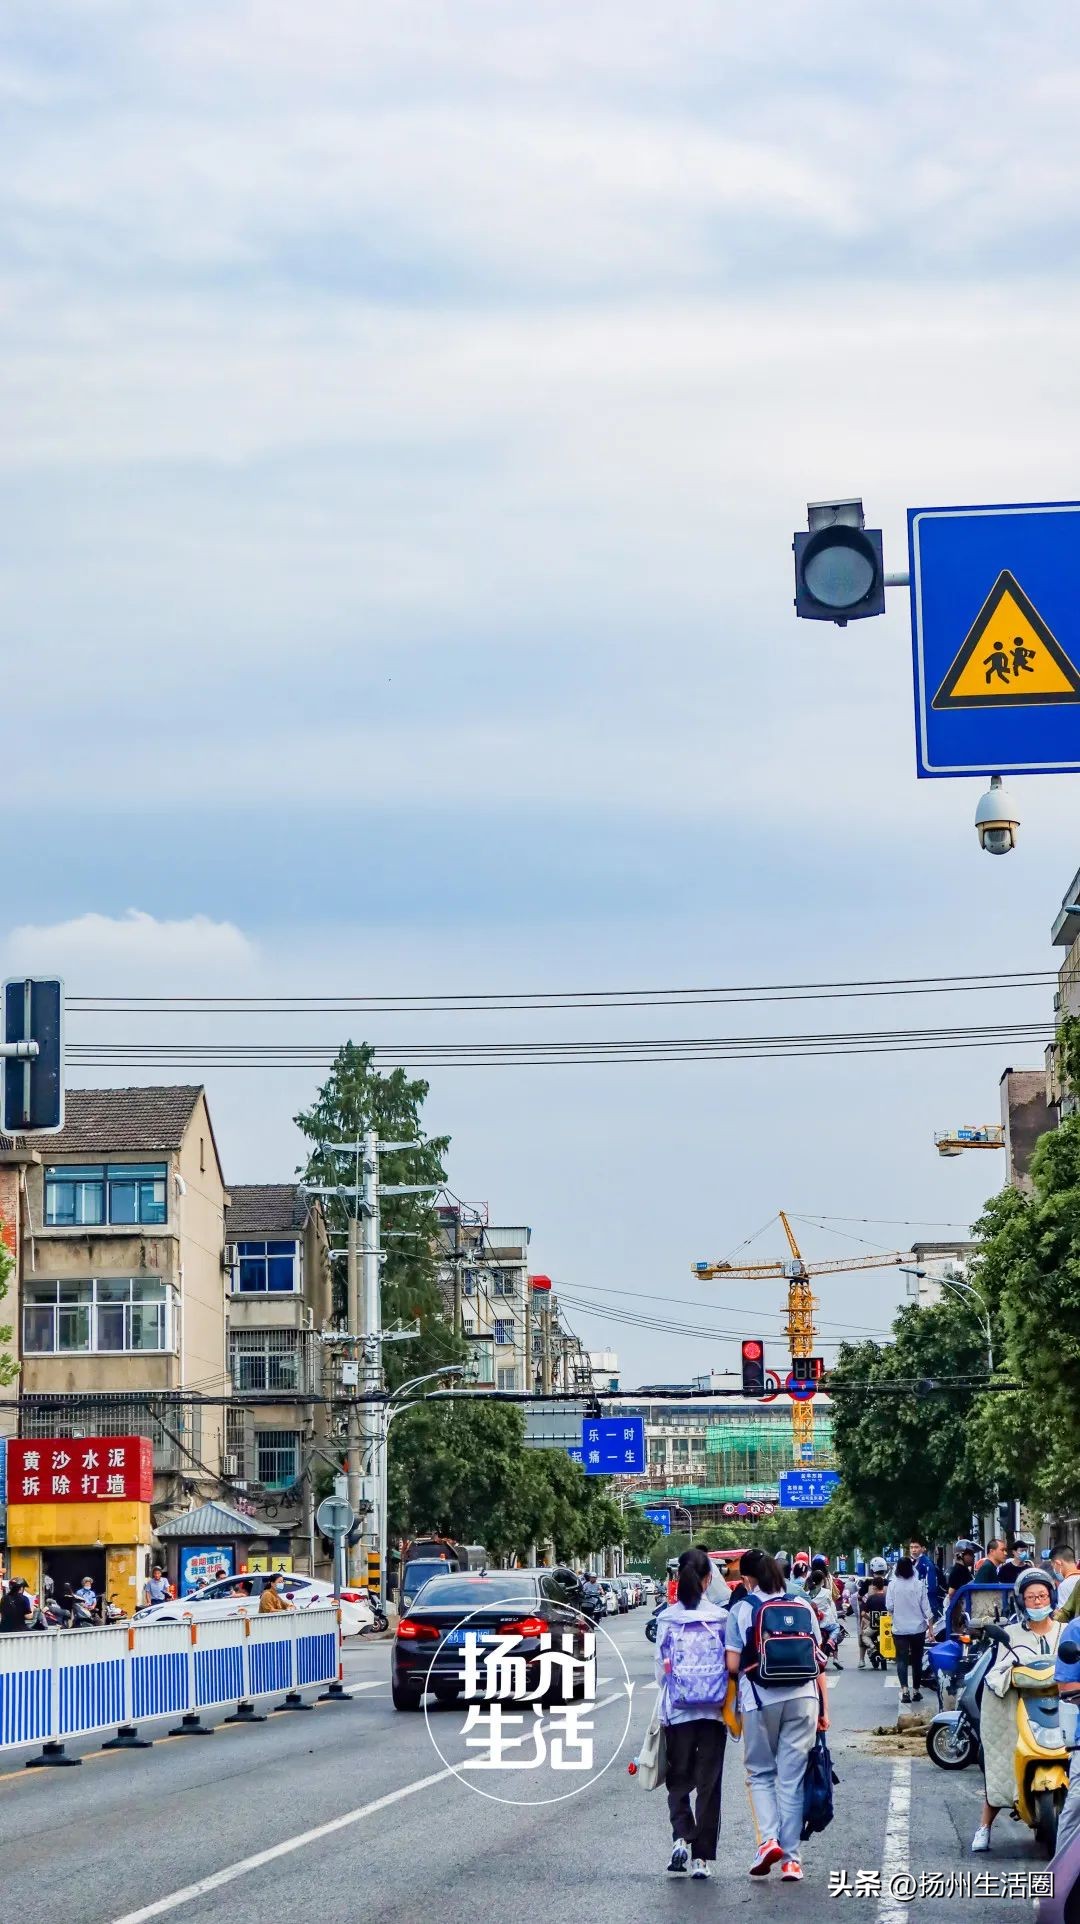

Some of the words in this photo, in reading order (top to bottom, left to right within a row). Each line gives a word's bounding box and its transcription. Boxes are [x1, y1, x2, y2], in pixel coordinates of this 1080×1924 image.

[588, 1427, 635, 1442] 乐一时
[22, 1448, 126, 1471] 黄沙水泥
[22, 1474, 126, 1496] 拆除打墙
